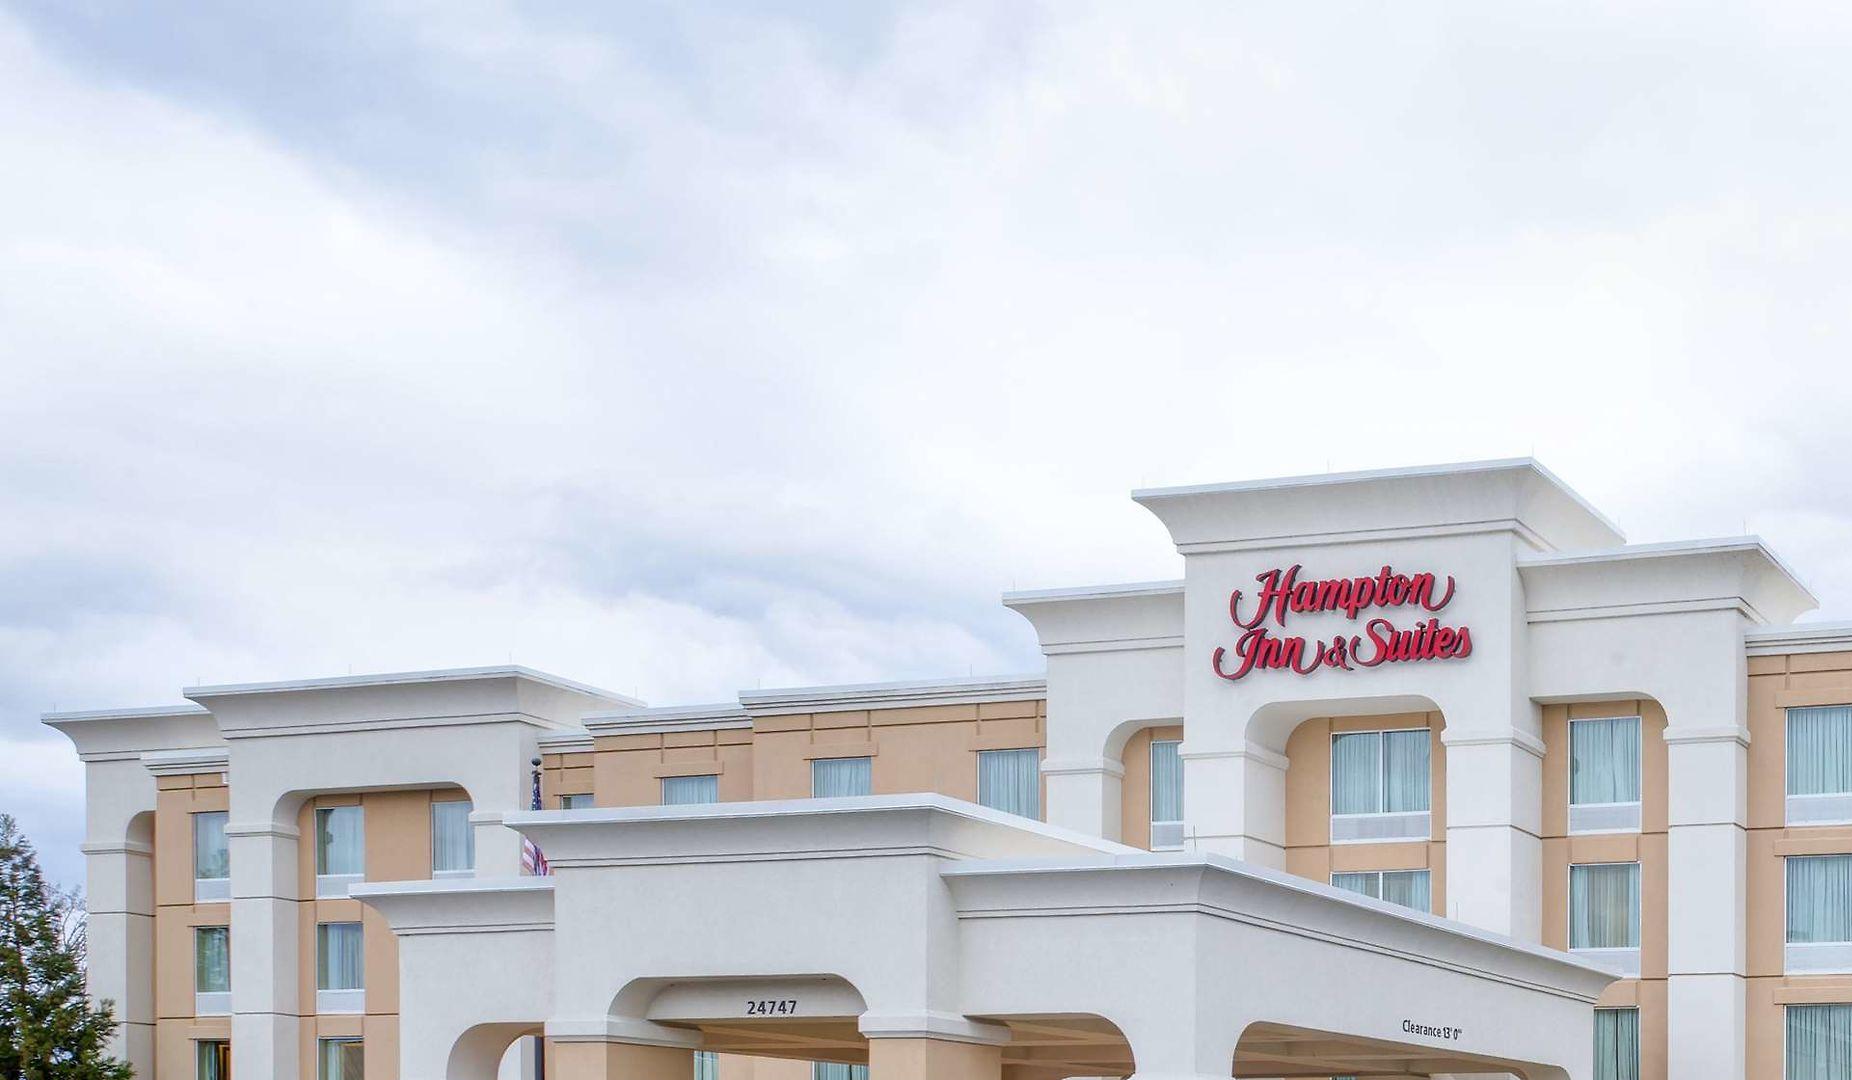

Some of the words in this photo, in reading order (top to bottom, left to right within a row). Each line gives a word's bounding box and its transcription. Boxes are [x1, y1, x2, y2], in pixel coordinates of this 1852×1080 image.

[1230, 564, 1456, 630] Hampton
[1213, 628, 1325, 681] Inn
[1324, 635, 1354, 671] &
[1350, 617, 1473, 667] Suites
[747, 1000, 797, 1015] 24747
[1402, 1019, 1442, 1038] Clearance
